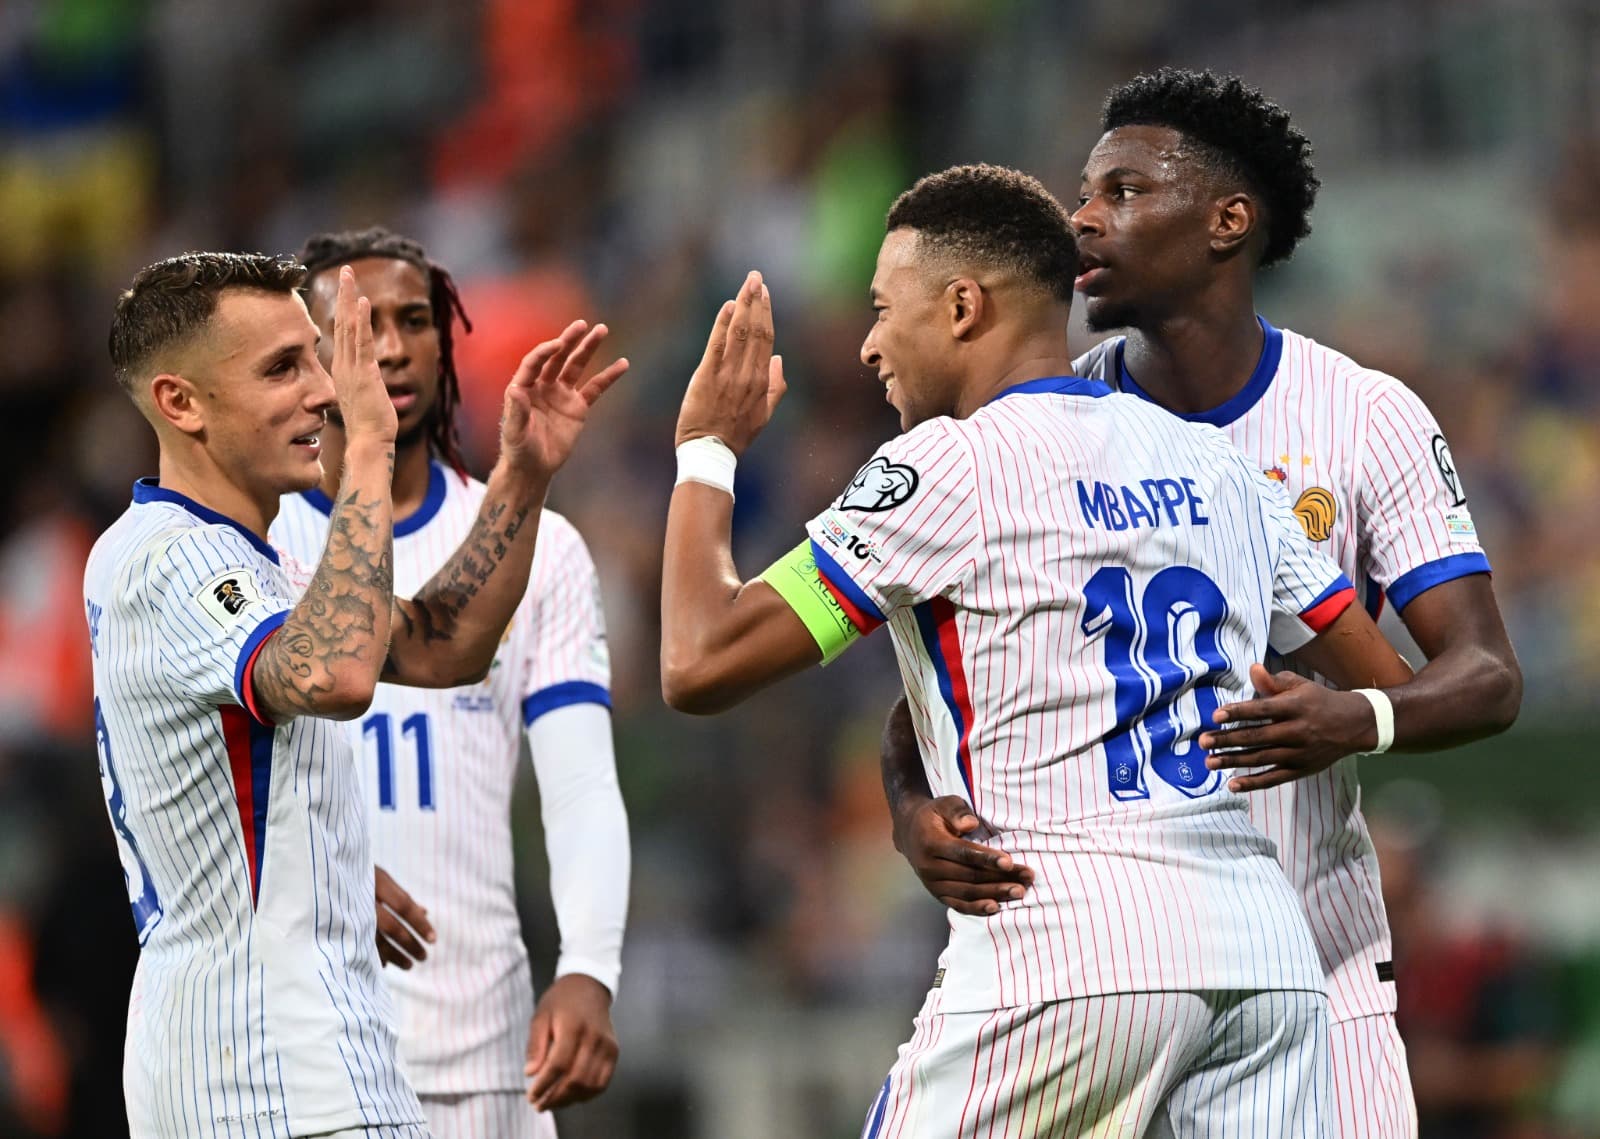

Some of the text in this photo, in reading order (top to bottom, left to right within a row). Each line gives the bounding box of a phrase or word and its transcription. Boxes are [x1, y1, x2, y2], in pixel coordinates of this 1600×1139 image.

[1077, 477, 1208, 531] MBAPPE
[1081, 566, 1232, 801] 10
[362, 713, 438, 812] 11
